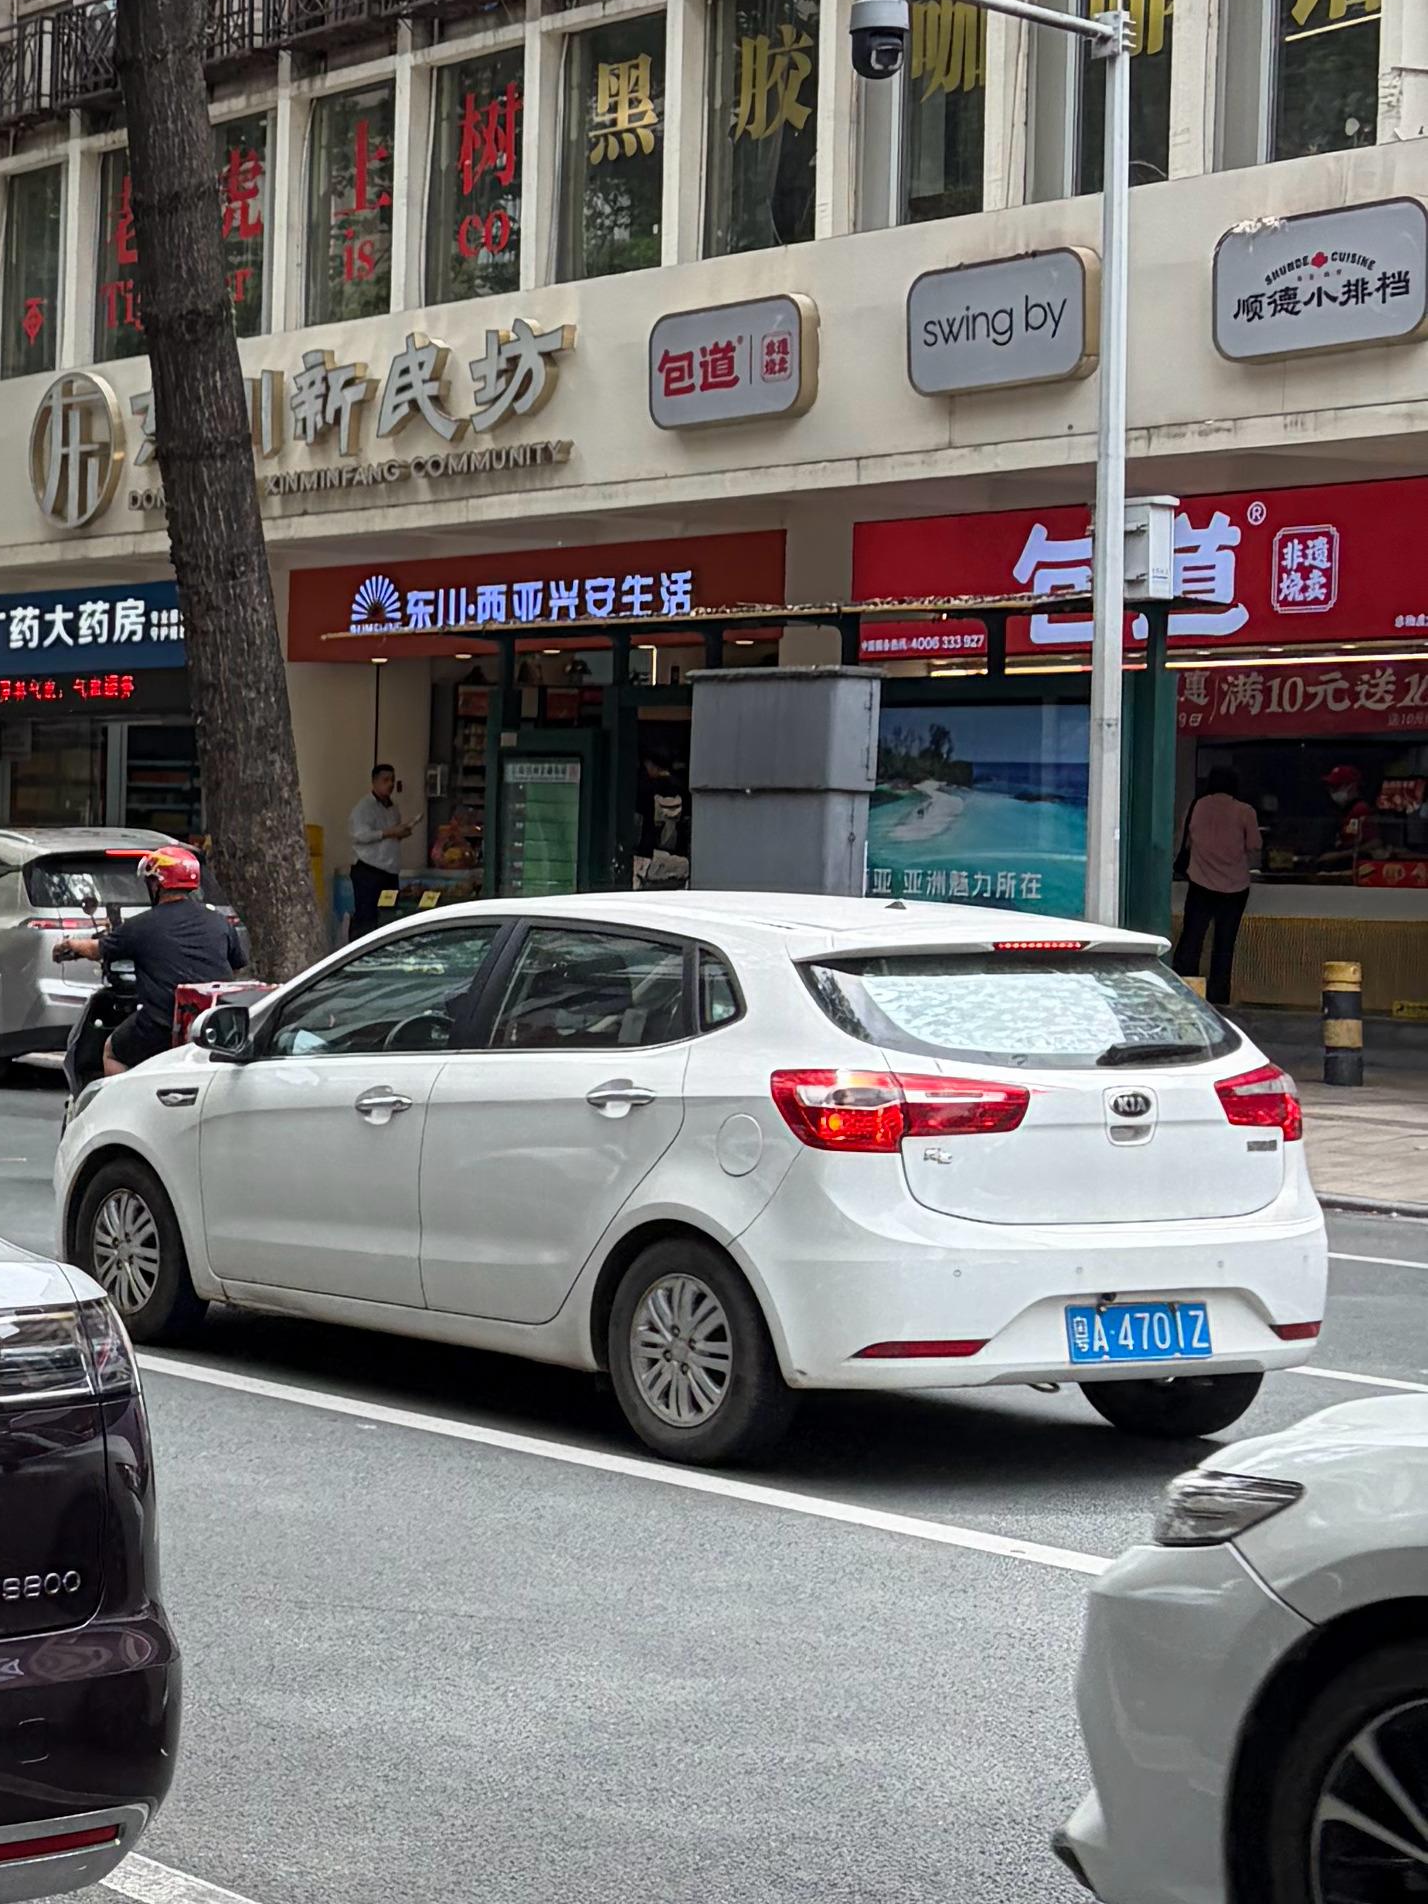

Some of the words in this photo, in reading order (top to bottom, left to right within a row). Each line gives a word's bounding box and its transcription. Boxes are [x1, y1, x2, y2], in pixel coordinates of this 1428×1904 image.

[344, 229, 375, 283] is
[1331, 251, 1376, 271] CUISINE
[1233, 270, 1411, 323] 顺德小排档
[923, 305, 1013, 347] swing
[1025, 295, 1067, 339] by
[658, 340, 740, 398] 包道
[264, 458, 401, 495] XINMINFANG
[410, 439, 570, 479] COMMUNITY
[1281, 536, 1332, 570] 非遗
[1278, 569, 1328, 601] 烧卖
[902, 868, 1042, 899] 亚洲魅力所在
[1116, 1096, 1147, 1123] KIA
[1072, 1309, 1210, 1353] 粤A·4701Z
